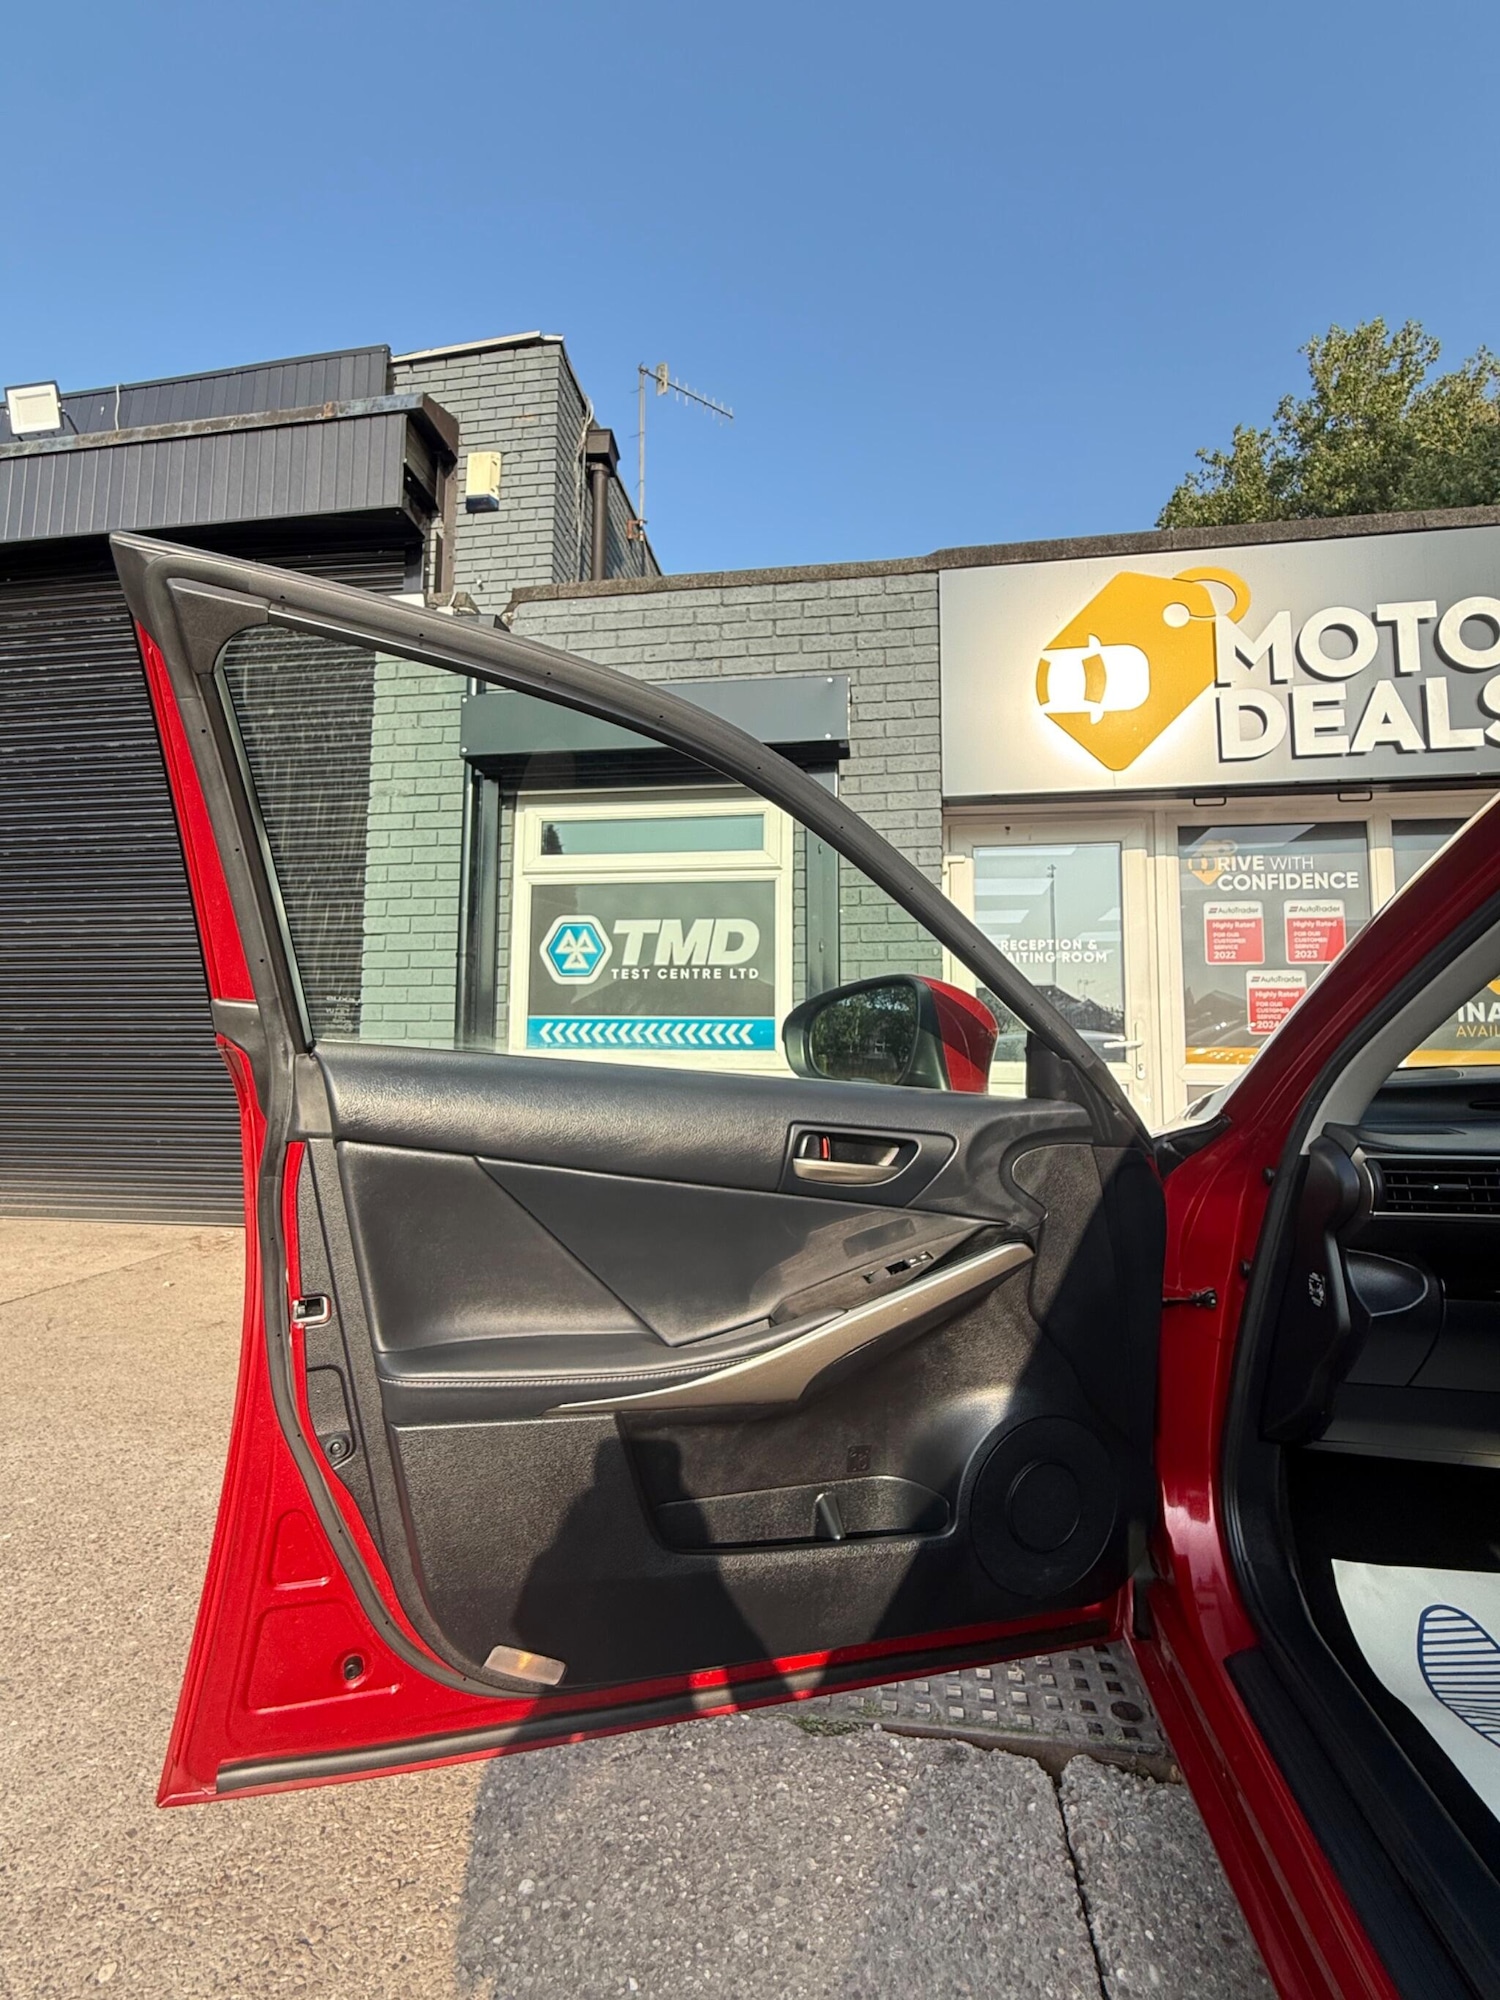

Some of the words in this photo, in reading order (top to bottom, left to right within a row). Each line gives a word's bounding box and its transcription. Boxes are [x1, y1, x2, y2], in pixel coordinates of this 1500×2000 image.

[1216, 596, 1500, 684] MOTO
[1269, 856, 1315, 871] WITH
[1217, 871, 1359, 891] CONFIDENCE
[1293, 920, 1315, 928] Highly
[613, 918, 760, 966] TMD
[1000, 939, 1083, 951] RECEPTION
[1087, 939, 1098, 950] &
[1005, 951, 1056, 963] AITING
[1061, 951, 1108, 963] ROOM
[1213, 951, 1237, 959] 2022
[1294, 950, 1318, 958] 2023
[611, 968, 650, 979] TEST
[657, 968, 722, 979] CENTRE
[729, 968, 759, 979] LTD
